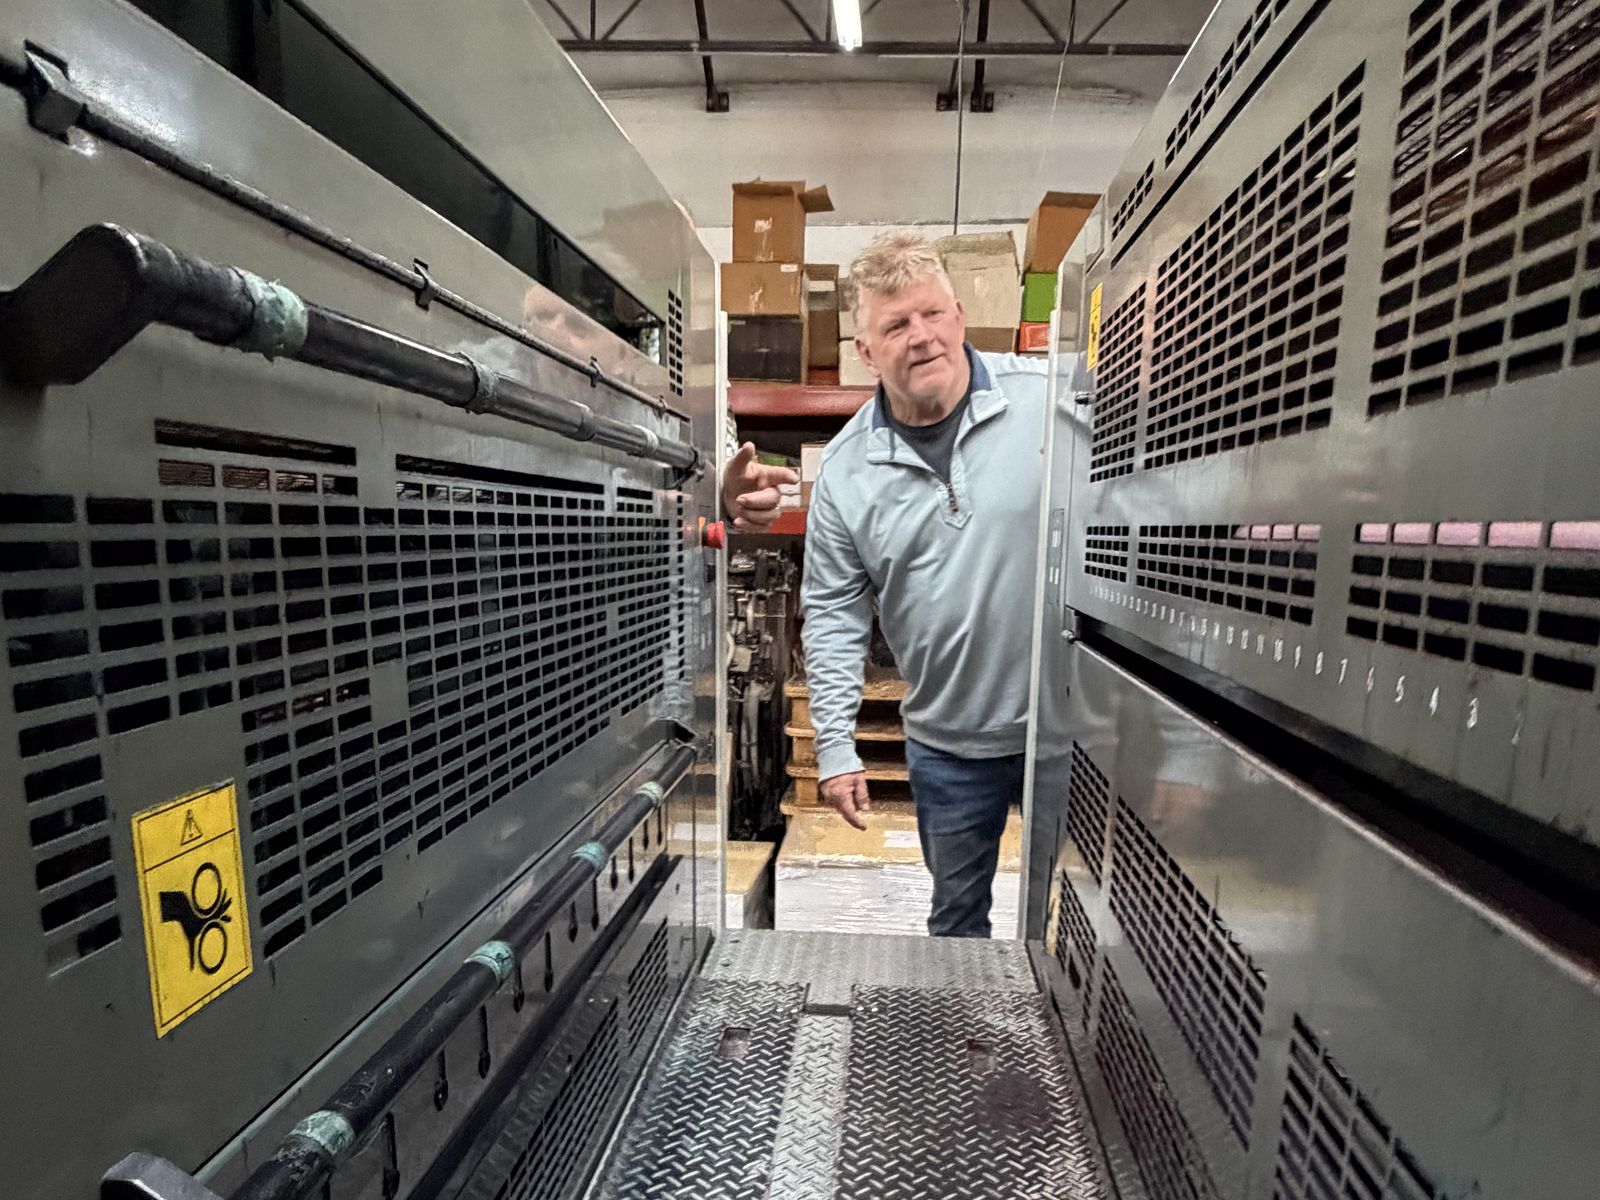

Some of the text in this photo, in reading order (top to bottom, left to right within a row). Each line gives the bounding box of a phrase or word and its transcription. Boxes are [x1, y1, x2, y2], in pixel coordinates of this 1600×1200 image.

[1314, 651, 1324, 676] 8
[1338, 658, 1348, 685] 7
[1394, 675, 1406, 703] 5
[1466, 697, 1479, 730] 3
